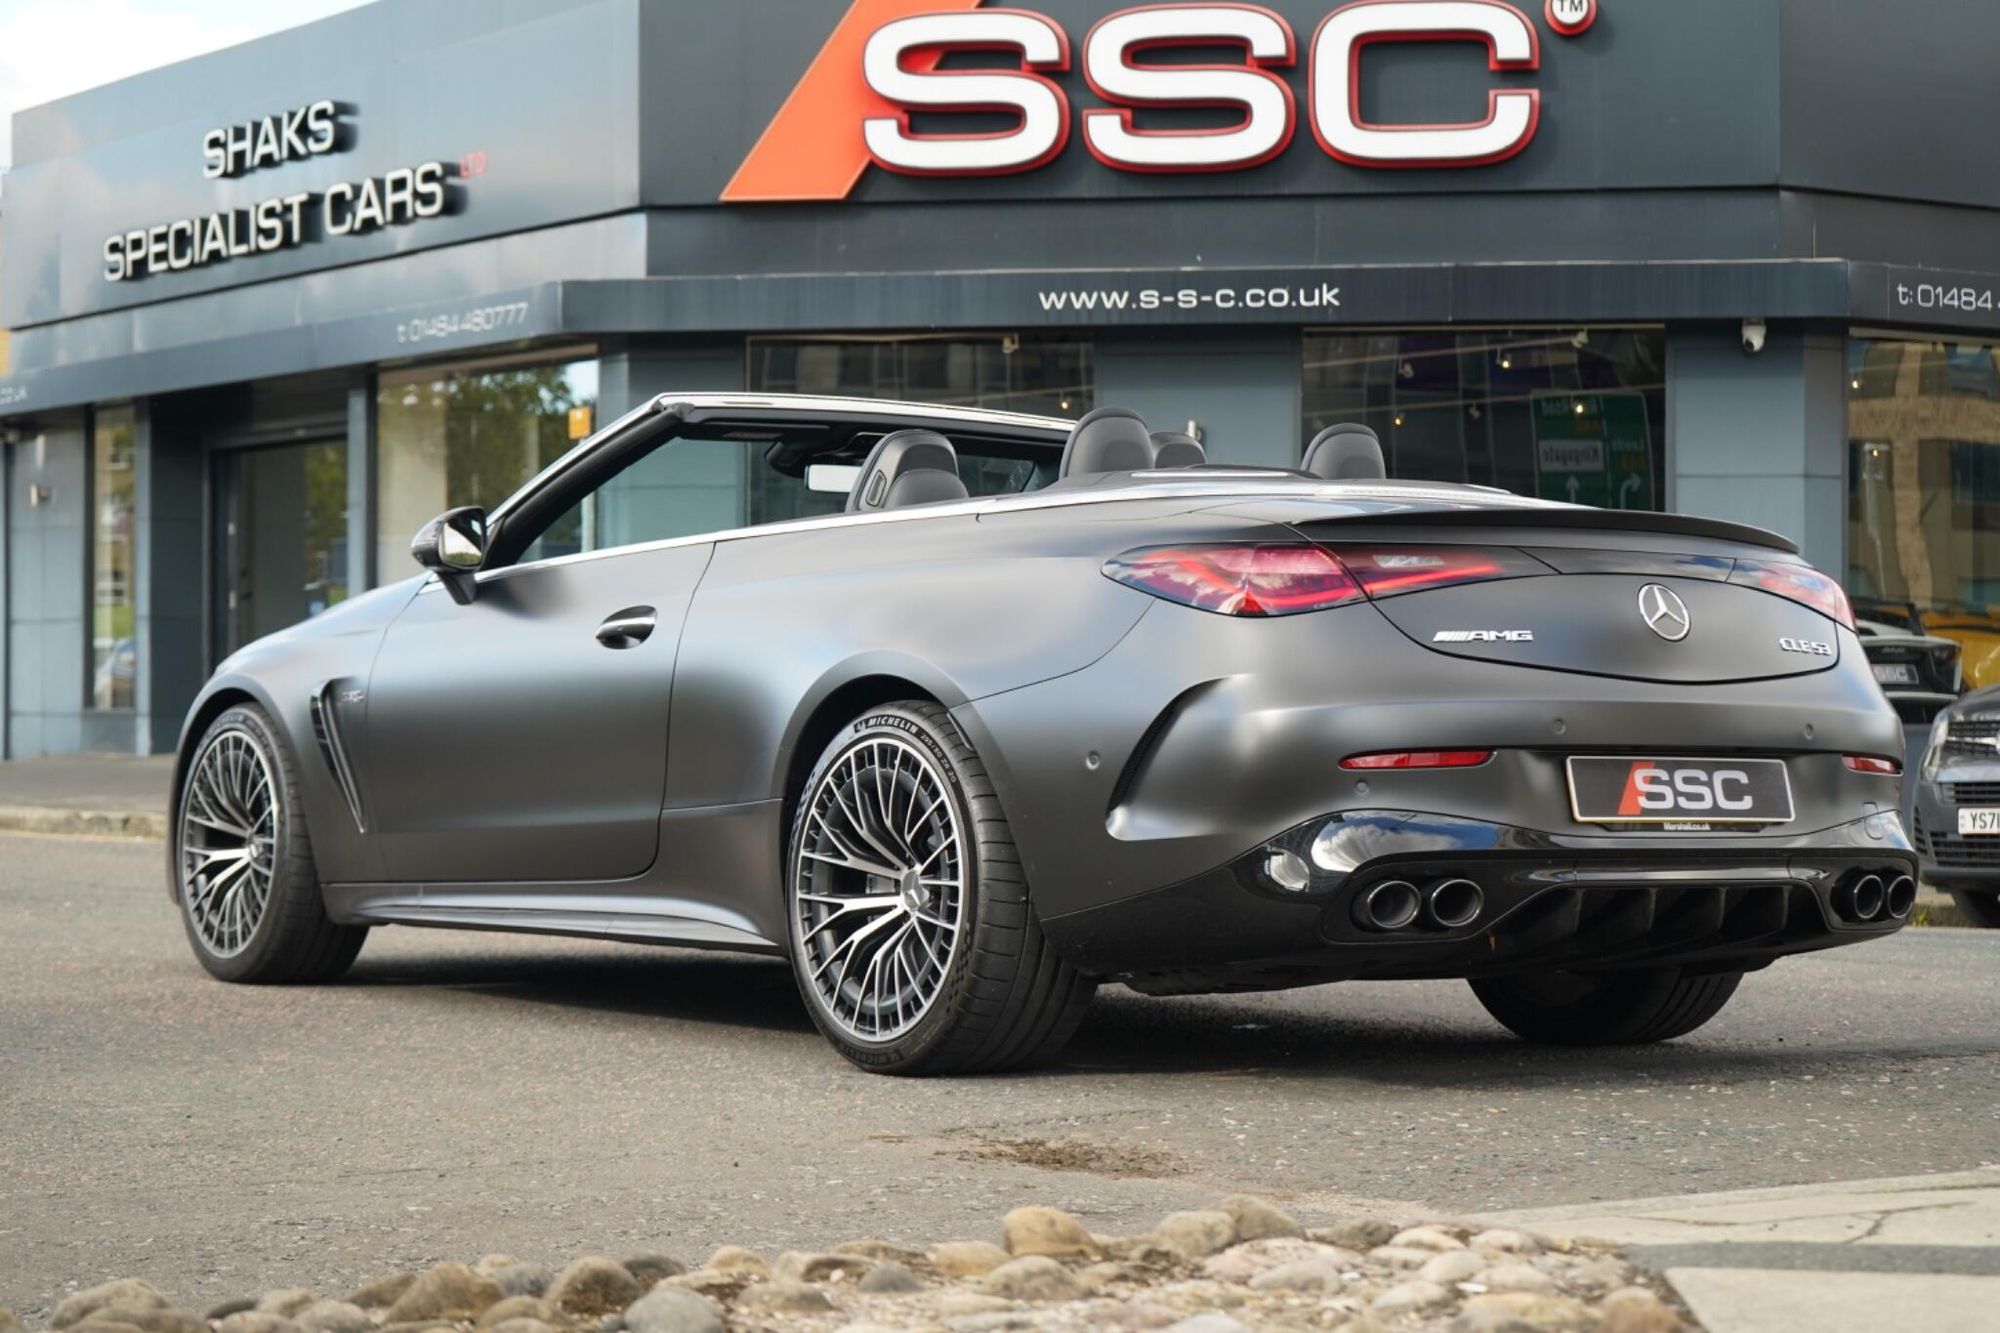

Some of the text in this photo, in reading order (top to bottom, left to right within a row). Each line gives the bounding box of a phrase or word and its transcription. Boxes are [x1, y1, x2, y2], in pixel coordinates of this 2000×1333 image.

[862, 1, 1540, 176] SSC
[203, 100, 335, 179] SHAKS
[103, 192, 310, 282] SPECIALIST
[324, 161, 444, 236] CARS
[1038, 283, 1341, 311] www.s-s-c.co.uk
[1467, 630, 1533, 642] AMG
[867, 716, 919, 735] MICHELIN
[1634, 768, 1753, 810] SSC
